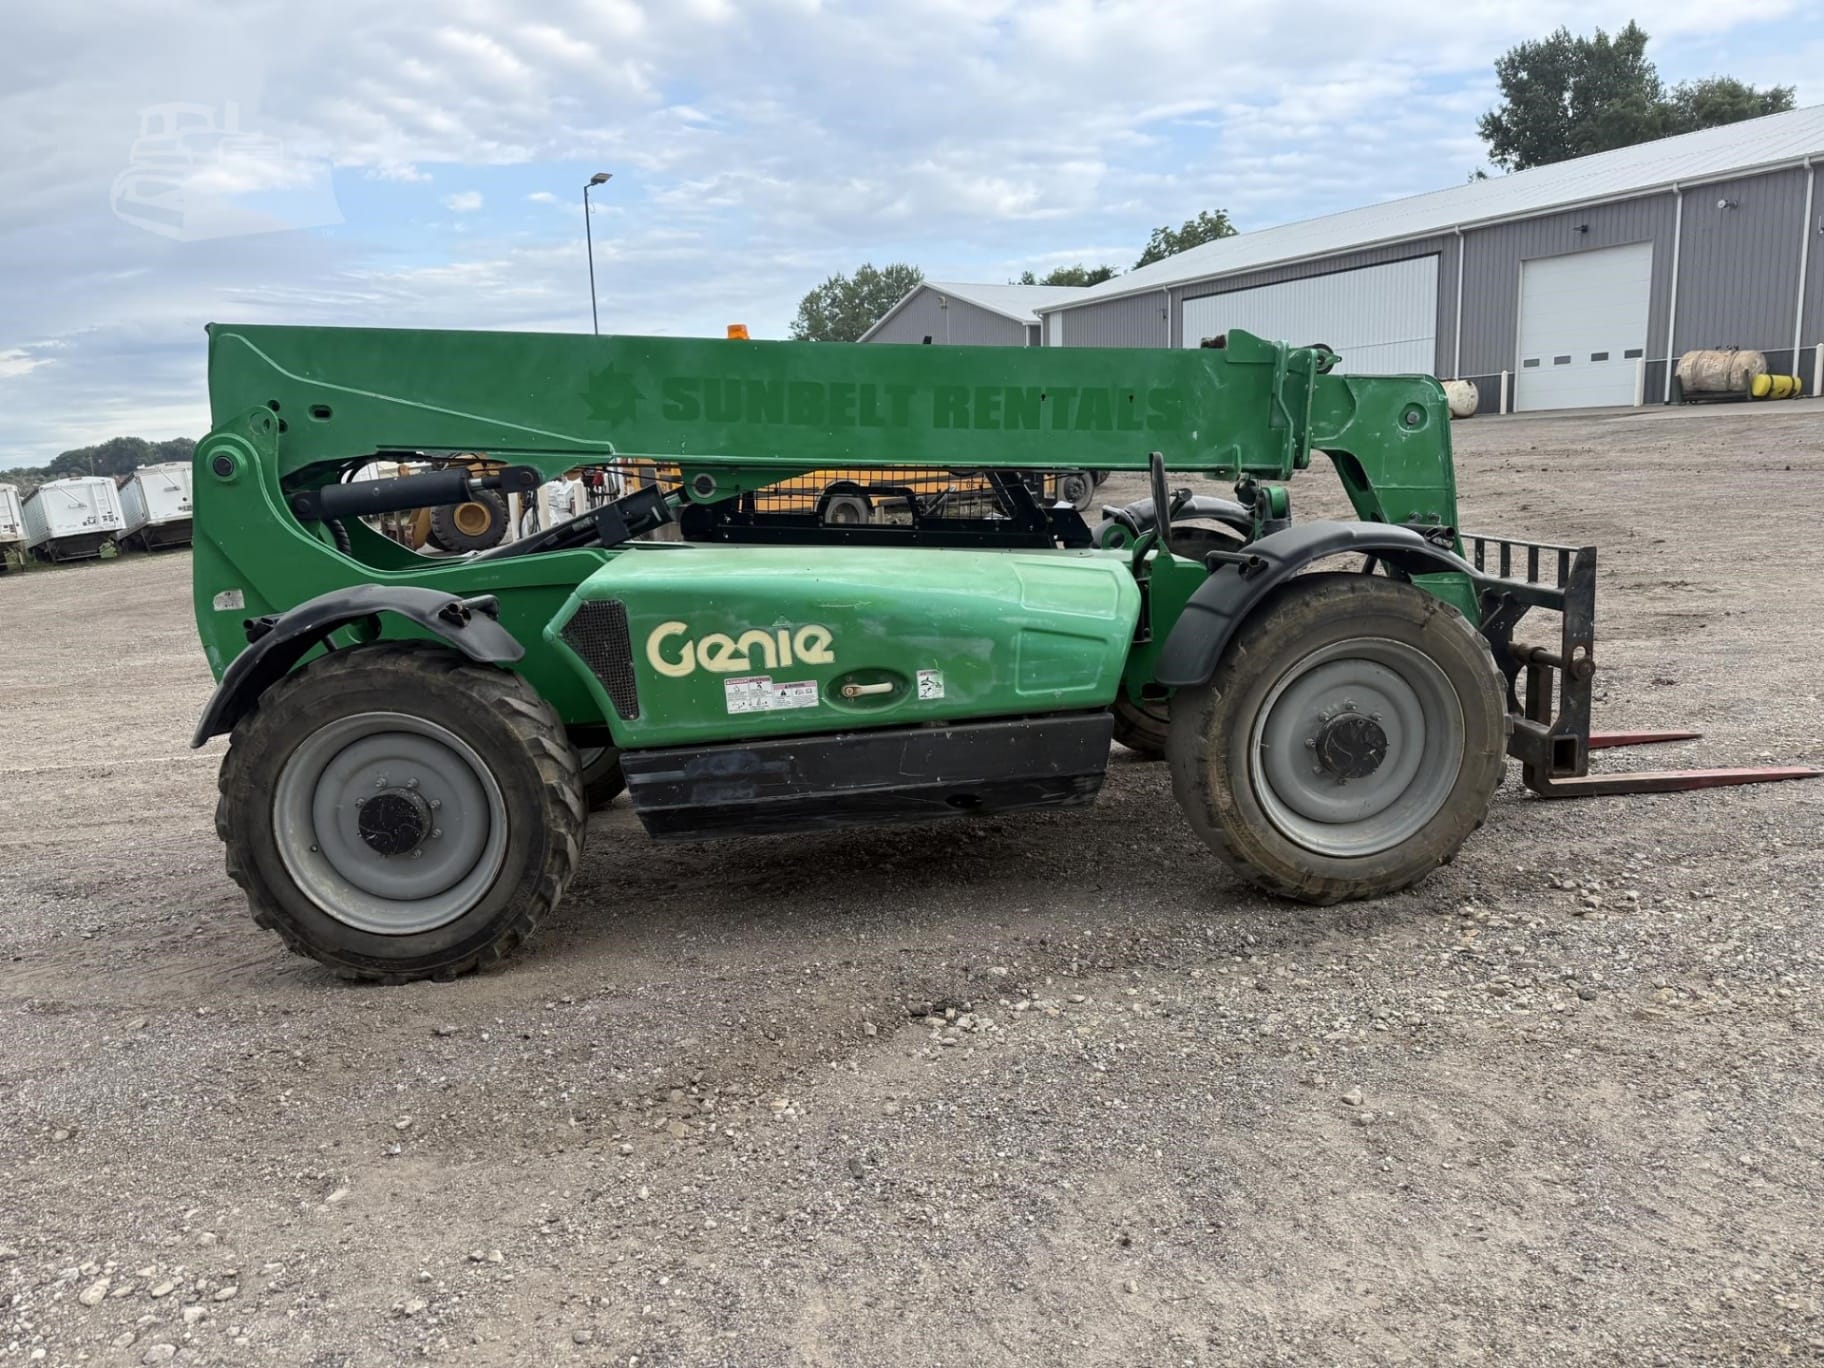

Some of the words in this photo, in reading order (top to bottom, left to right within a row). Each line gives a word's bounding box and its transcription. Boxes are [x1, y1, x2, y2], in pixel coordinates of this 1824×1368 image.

[661, 376, 917, 428] SUNBELT
[933, 385, 1184, 431] RENTALS
[646, 621, 835, 678] Genie
